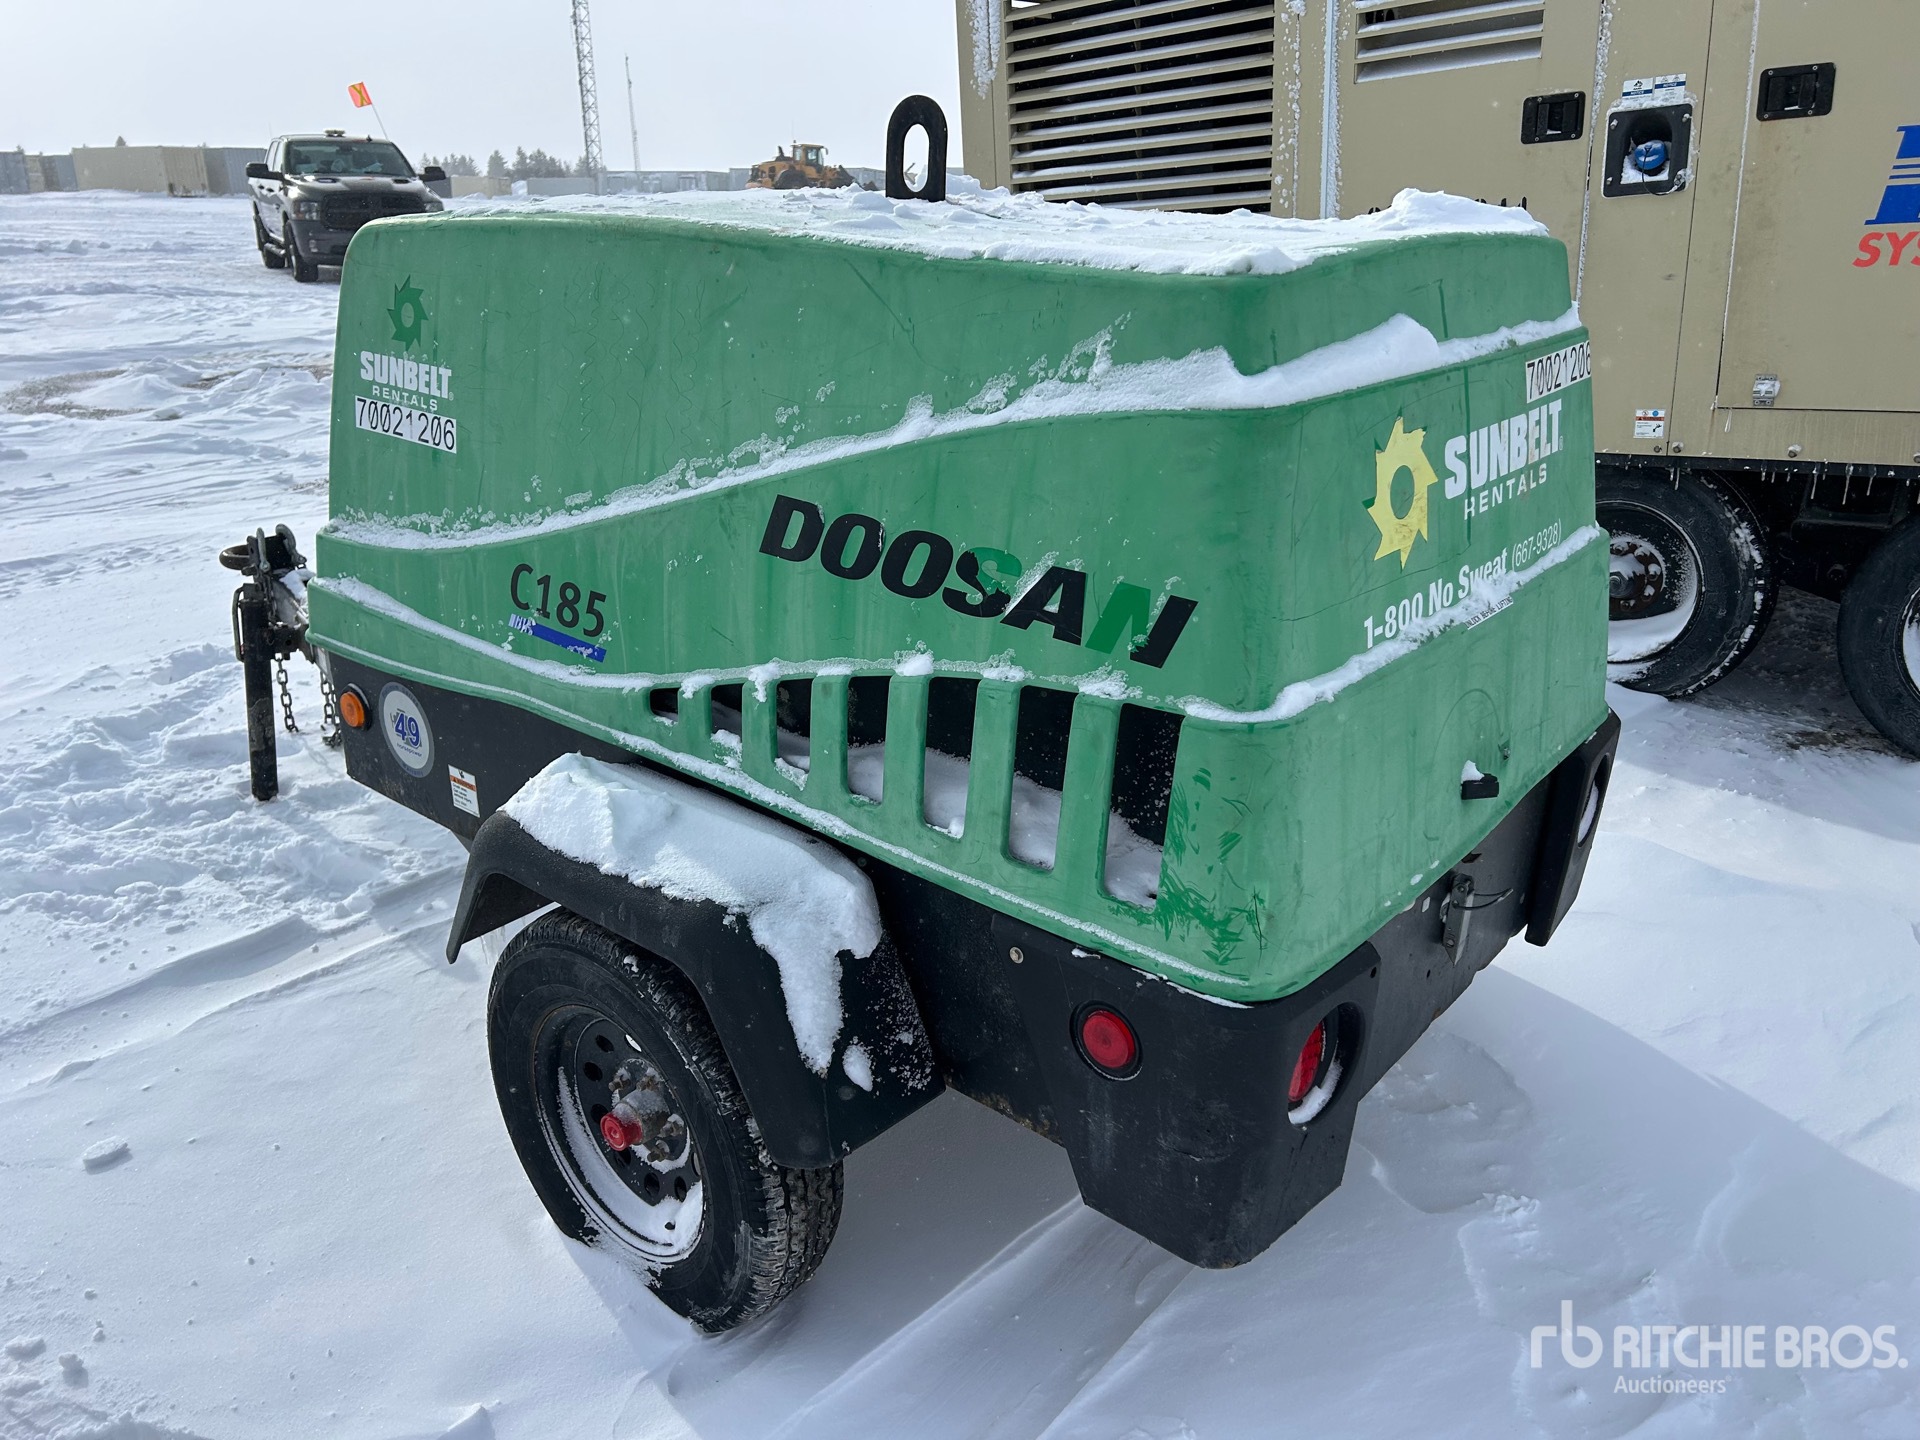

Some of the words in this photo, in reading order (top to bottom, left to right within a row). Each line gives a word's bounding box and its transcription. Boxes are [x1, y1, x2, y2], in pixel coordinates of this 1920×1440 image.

[1852, 231, 1920, 267] SY
[360, 350, 452, 399] SUNBELT
[372, 385, 438, 411] RENTALS
[1527, 341, 1591, 400] 70021206
[357, 398, 455, 450] 70021206
[1444, 398, 1562, 499] SUNBELT
[1464, 462, 1547, 520] RENTALS
[510, 563, 607, 637] C185
[759, 494, 1199, 669] DOOSAN
[1364, 592, 1424, 649] 1-800
[1429, 578, 1454, 616] No
[1457, 547, 1508, 599] Sweat
[1512, 518, 1562, 573] (667-9328)
[395, 712, 420, 748] 49
